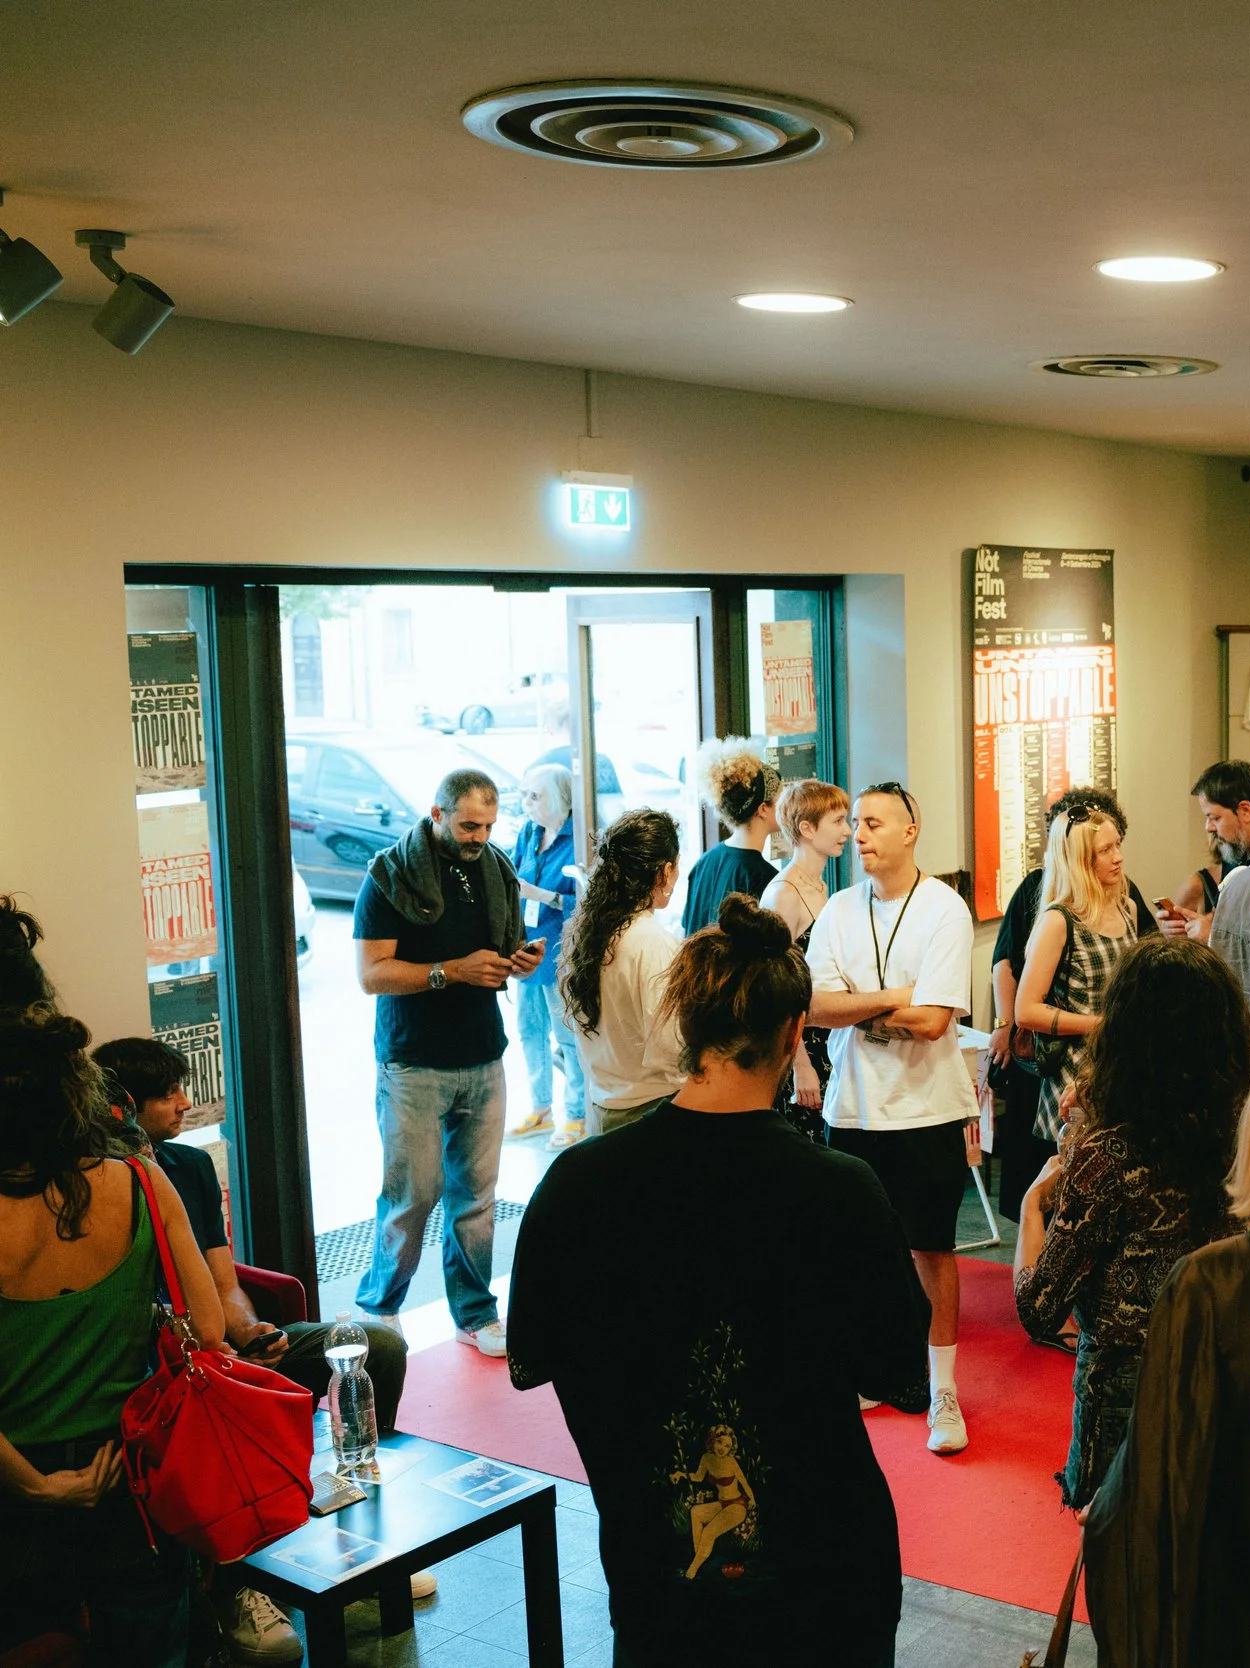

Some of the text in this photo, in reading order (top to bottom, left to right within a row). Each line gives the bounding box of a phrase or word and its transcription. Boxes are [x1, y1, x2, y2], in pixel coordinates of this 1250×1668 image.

[976, 546, 999, 572] Nòt
[975, 573, 1005, 595] Film
[975, 596, 1007, 619] Fest
[131, 686, 198, 698] TAMED
[975, 666, 1115, 725] UNSTOPPABLE
[132, 697, 199, 714] SEEN
[132, 711, 202, 769] TOPPABLE
[142, 854, 209, 874] TAMED
[142, 865, 209, 888] SEEN
[143, 879, 213, 940] TOPPABLE
[153, 1024, 219, 1043] TAMED
[172, 1034, 220, 1054] EEN
